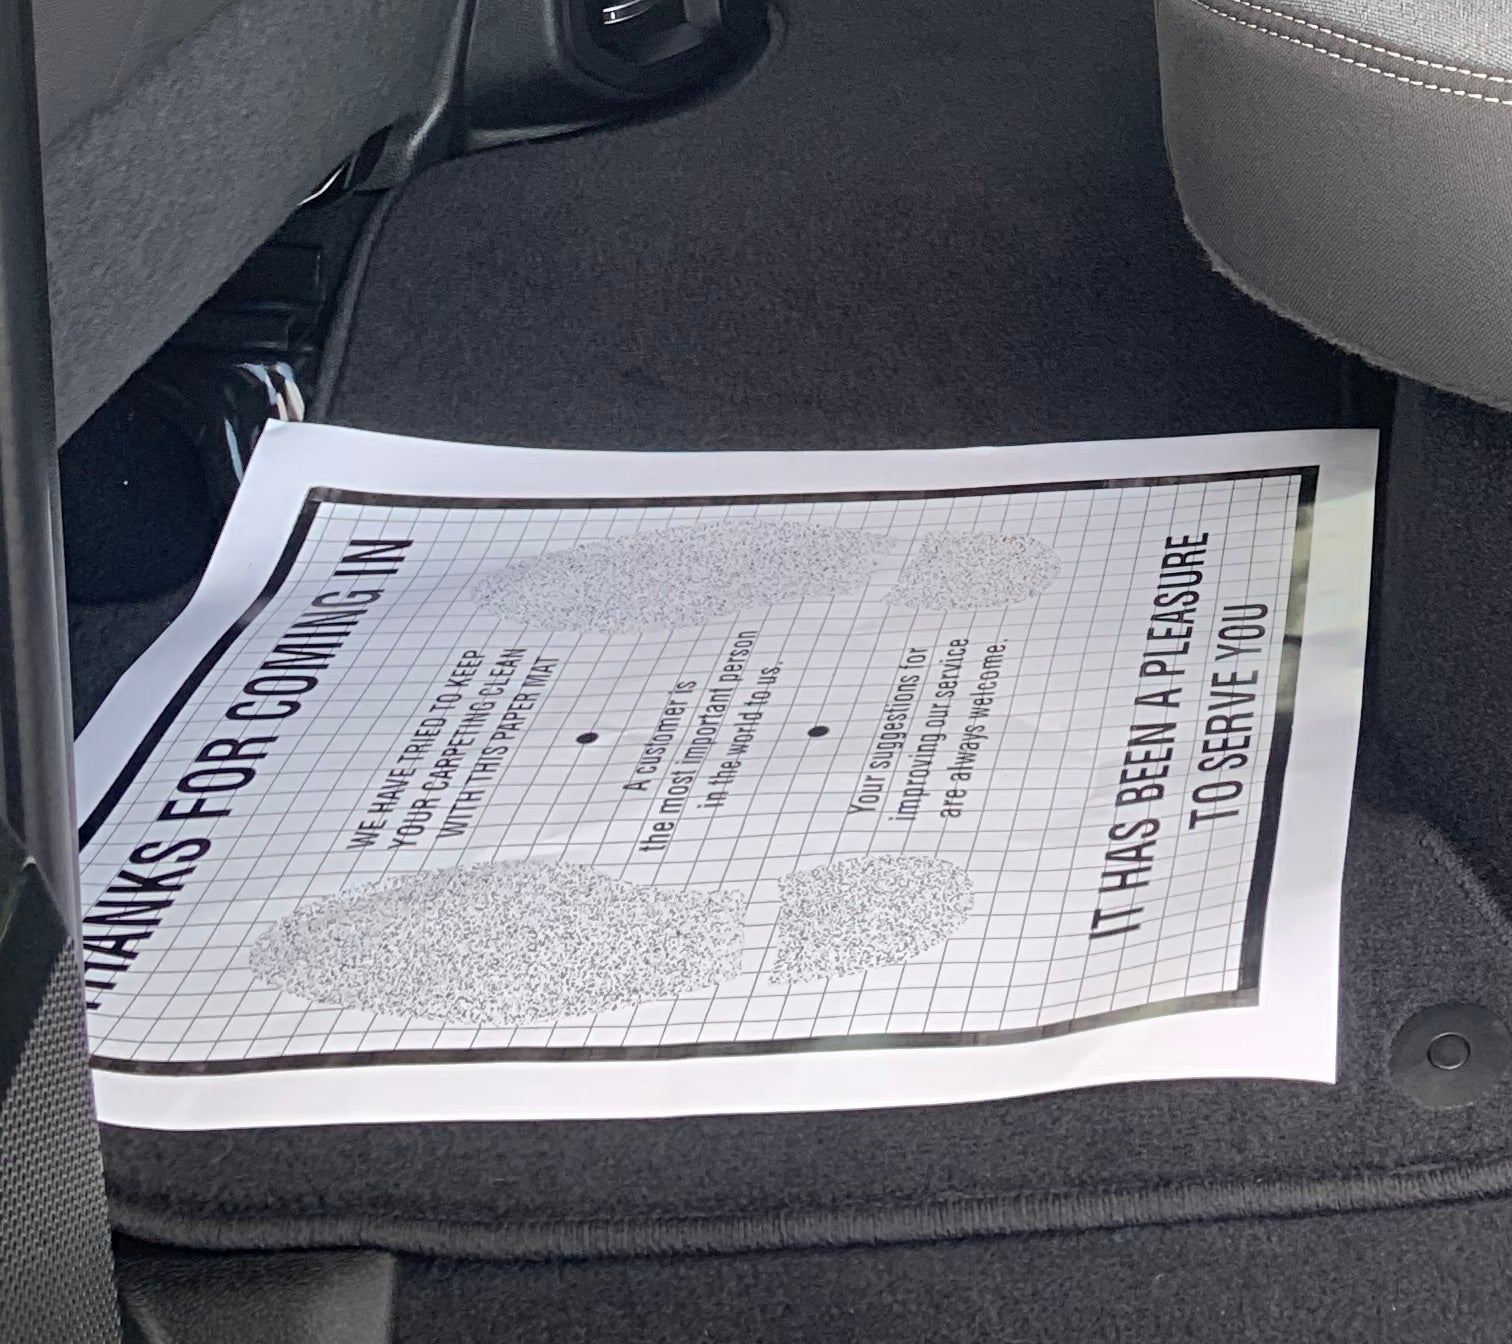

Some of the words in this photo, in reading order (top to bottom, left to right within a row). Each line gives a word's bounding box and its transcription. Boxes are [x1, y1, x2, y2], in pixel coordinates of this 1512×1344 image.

[1139, 532, 1210, 678] PLEASURE
[718, 630, 758, 683] person
[1215, 603, 1269, 662] YOU
[444, 650, 486, 688] KEEP
[756, 661, 784, 685] us.
[935, 638, 969, 700] service
[968, 638, 1009, 720] welcome.
[429, 693, 462, 712] TO
[744, 690, 771, 706] to
[926, 703, 951, 728] our
[1134, 686, 1183, 708] A
[1198, 669, 1260, 772] SERVE
[388, 796, 442, 850] YOUR
[422, 701, 495, 791] CARPETING
[478, 648, 527, 697] CLEAN
[397, 718, 448, 764] TRIED
[437, 790, 486, 838] WITH
[465, 746, 508, 785] THIS
[490, 692, 541, 742] PAPER
[522, 656, 560, 688] MAT
[622, 778, 650, 792] A
[636, 699, 688, 774] customer
[668, 680, 697, 695] is
[675, 687, 734, 764] important
[727, 711, 765, 755] world
[848, 774, 886, 814] Your
[870, 674, 920, 769] suggestions
[898, 648, 928, 670] for
[82, 837, 211, 1010] ANKS
[156, 734, 280, 823] FOR
[224, 587, 386, 721] COMING
[333, 538, 416, 577] IN
[708, 761, 742, 786] the
[888, 732, 947, 822] improving
[946, 724, 989, 782] always
[1115, 721, 1178, 808] BEEN
[367, 768, 416, 814] HAVE
[659, 769, 698, 814] most
[697, 790, 728, 809] in
[940, 788, 966, 818] are
[1189, 778, 1244, 829] TO
[346, 819, 387, 850] WE
[639, 821, 674, 852] the
[1098, 816, 1161, 894] HAS
[1088, 906, 1144, 940] IT
